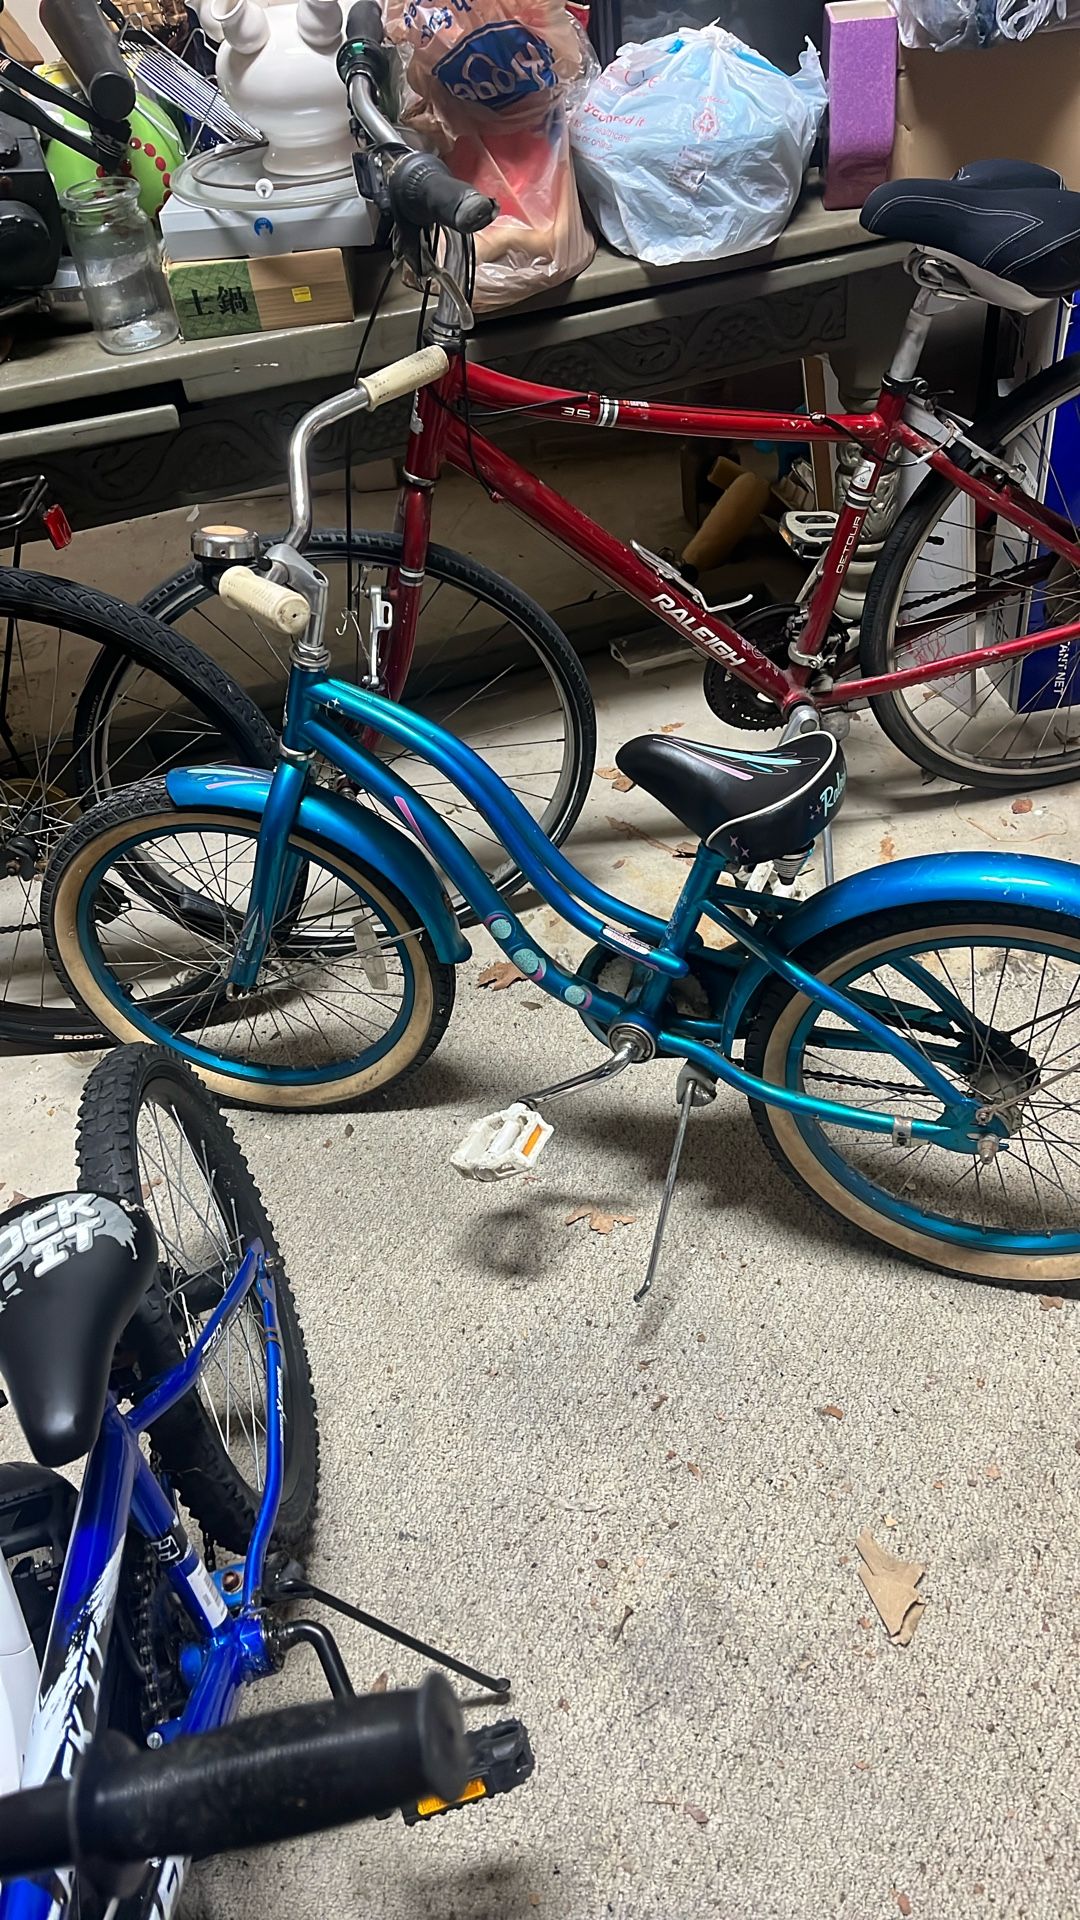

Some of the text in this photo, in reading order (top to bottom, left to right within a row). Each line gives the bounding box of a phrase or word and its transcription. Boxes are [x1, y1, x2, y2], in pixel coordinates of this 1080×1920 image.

[185, 285, 249, 318] 土鍋
[836, 515, 861, 574] DETOUR
[650, 593, 746, 667] RALEIGH
[1053, 641, 1071, 696] ANT NET
